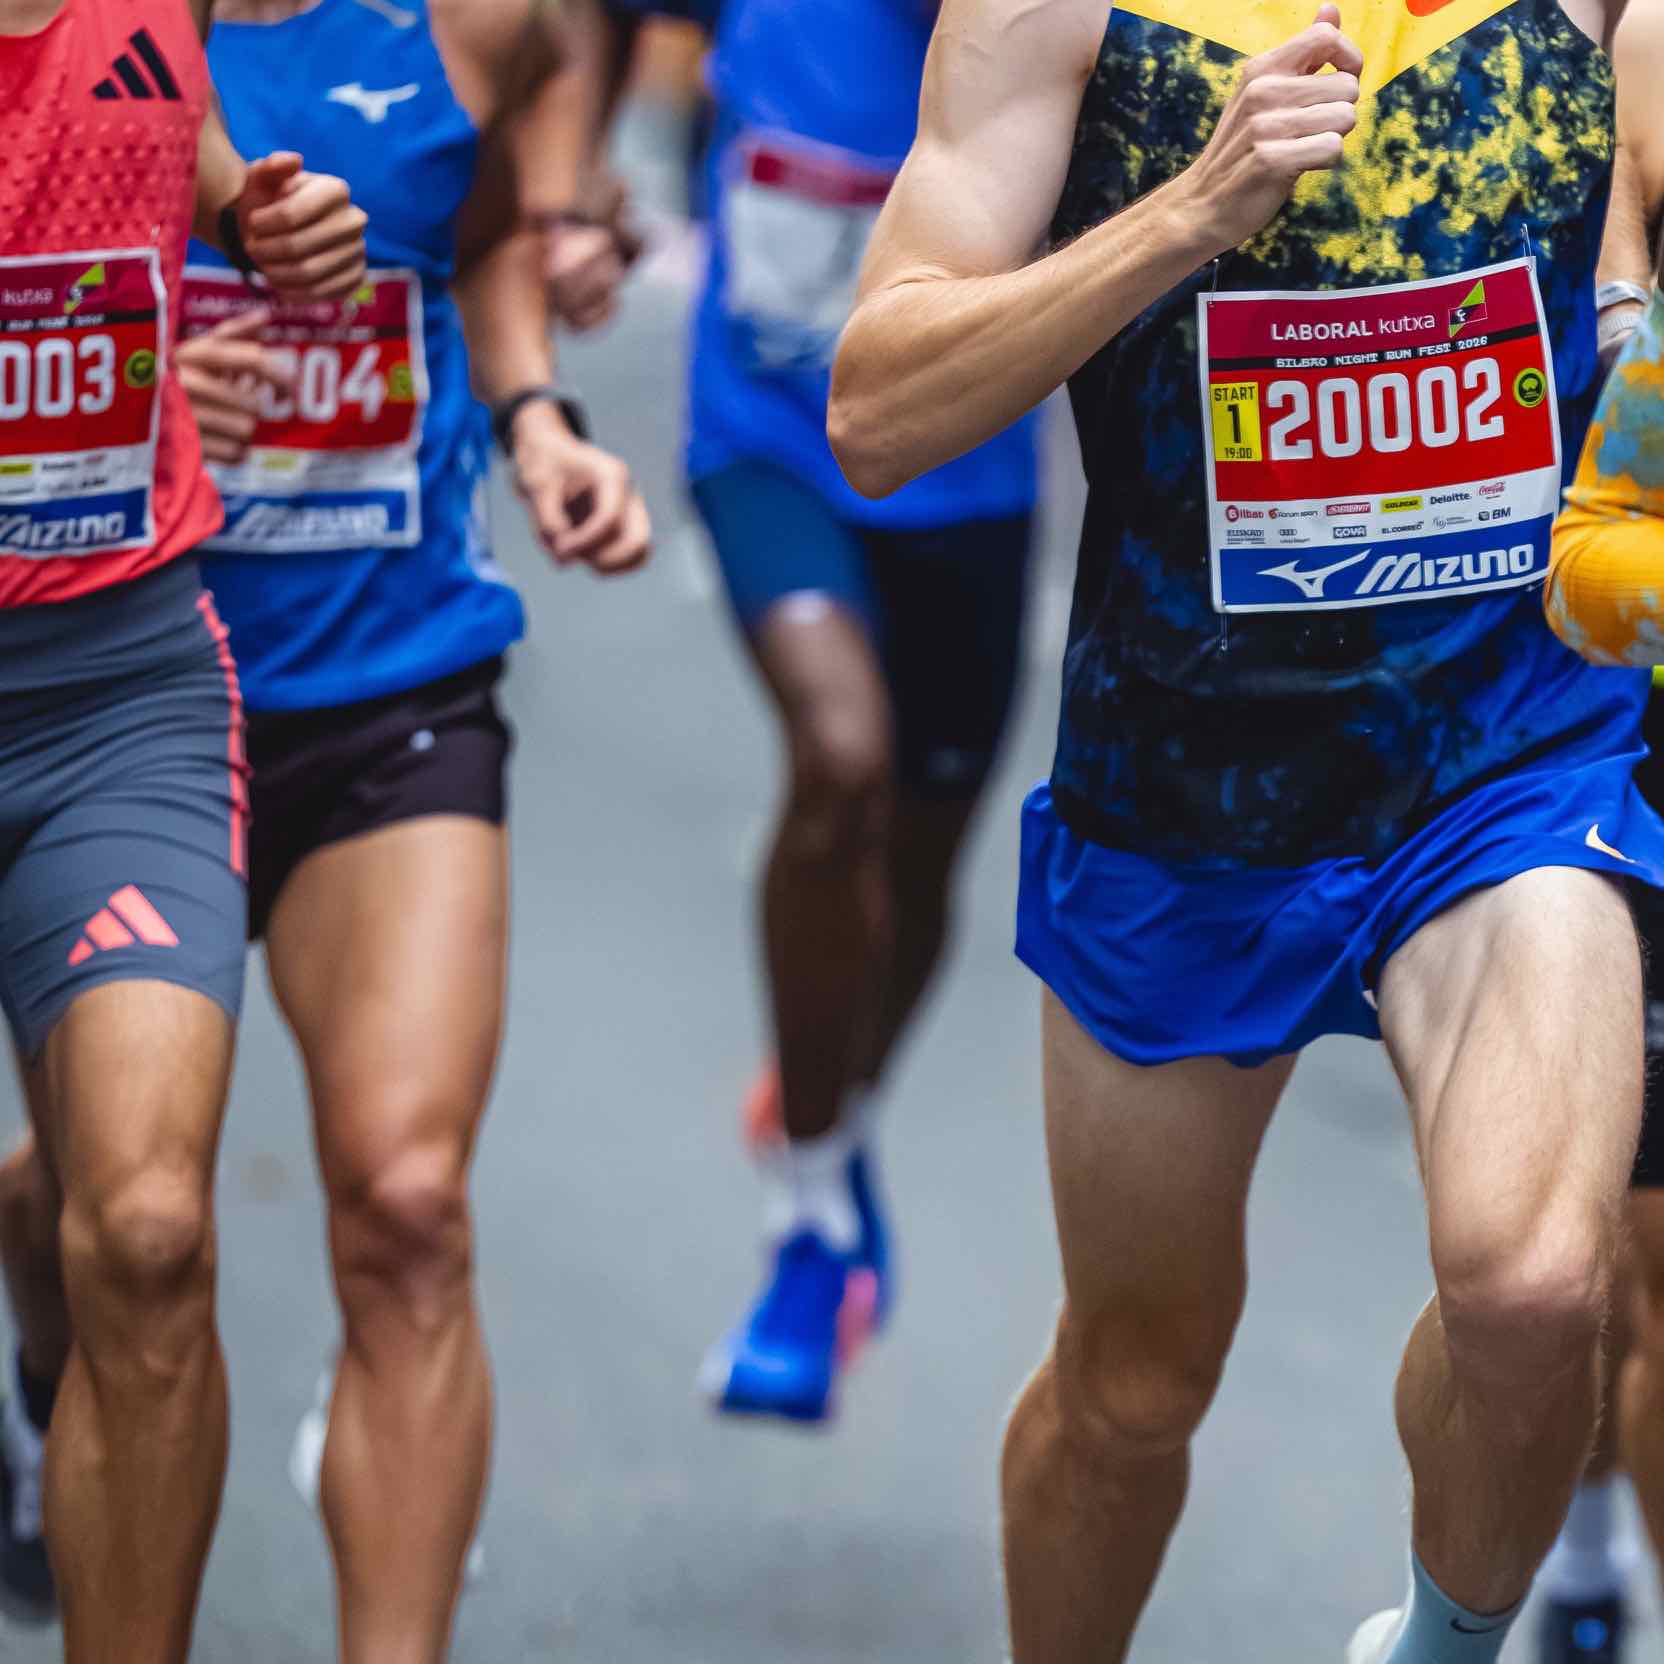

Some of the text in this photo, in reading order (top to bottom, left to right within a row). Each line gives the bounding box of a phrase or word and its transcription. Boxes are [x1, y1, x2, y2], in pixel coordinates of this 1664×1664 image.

[1271, 313, 1436, 341] LABORAL kutxa
[1335, 352, 1379, 365] NIGHT
[1386, 348, 1412, 361] RUN
[1419, 343, 1451, 356] FEST
[1214, 386, 1256, 402] START
[1267, 358, 1505, 461] 20002
[1227, 404, 1242, 444] 1
[1224, 447, 1253, 459] 19:00
[1492, 507, 1511, 520] BM
